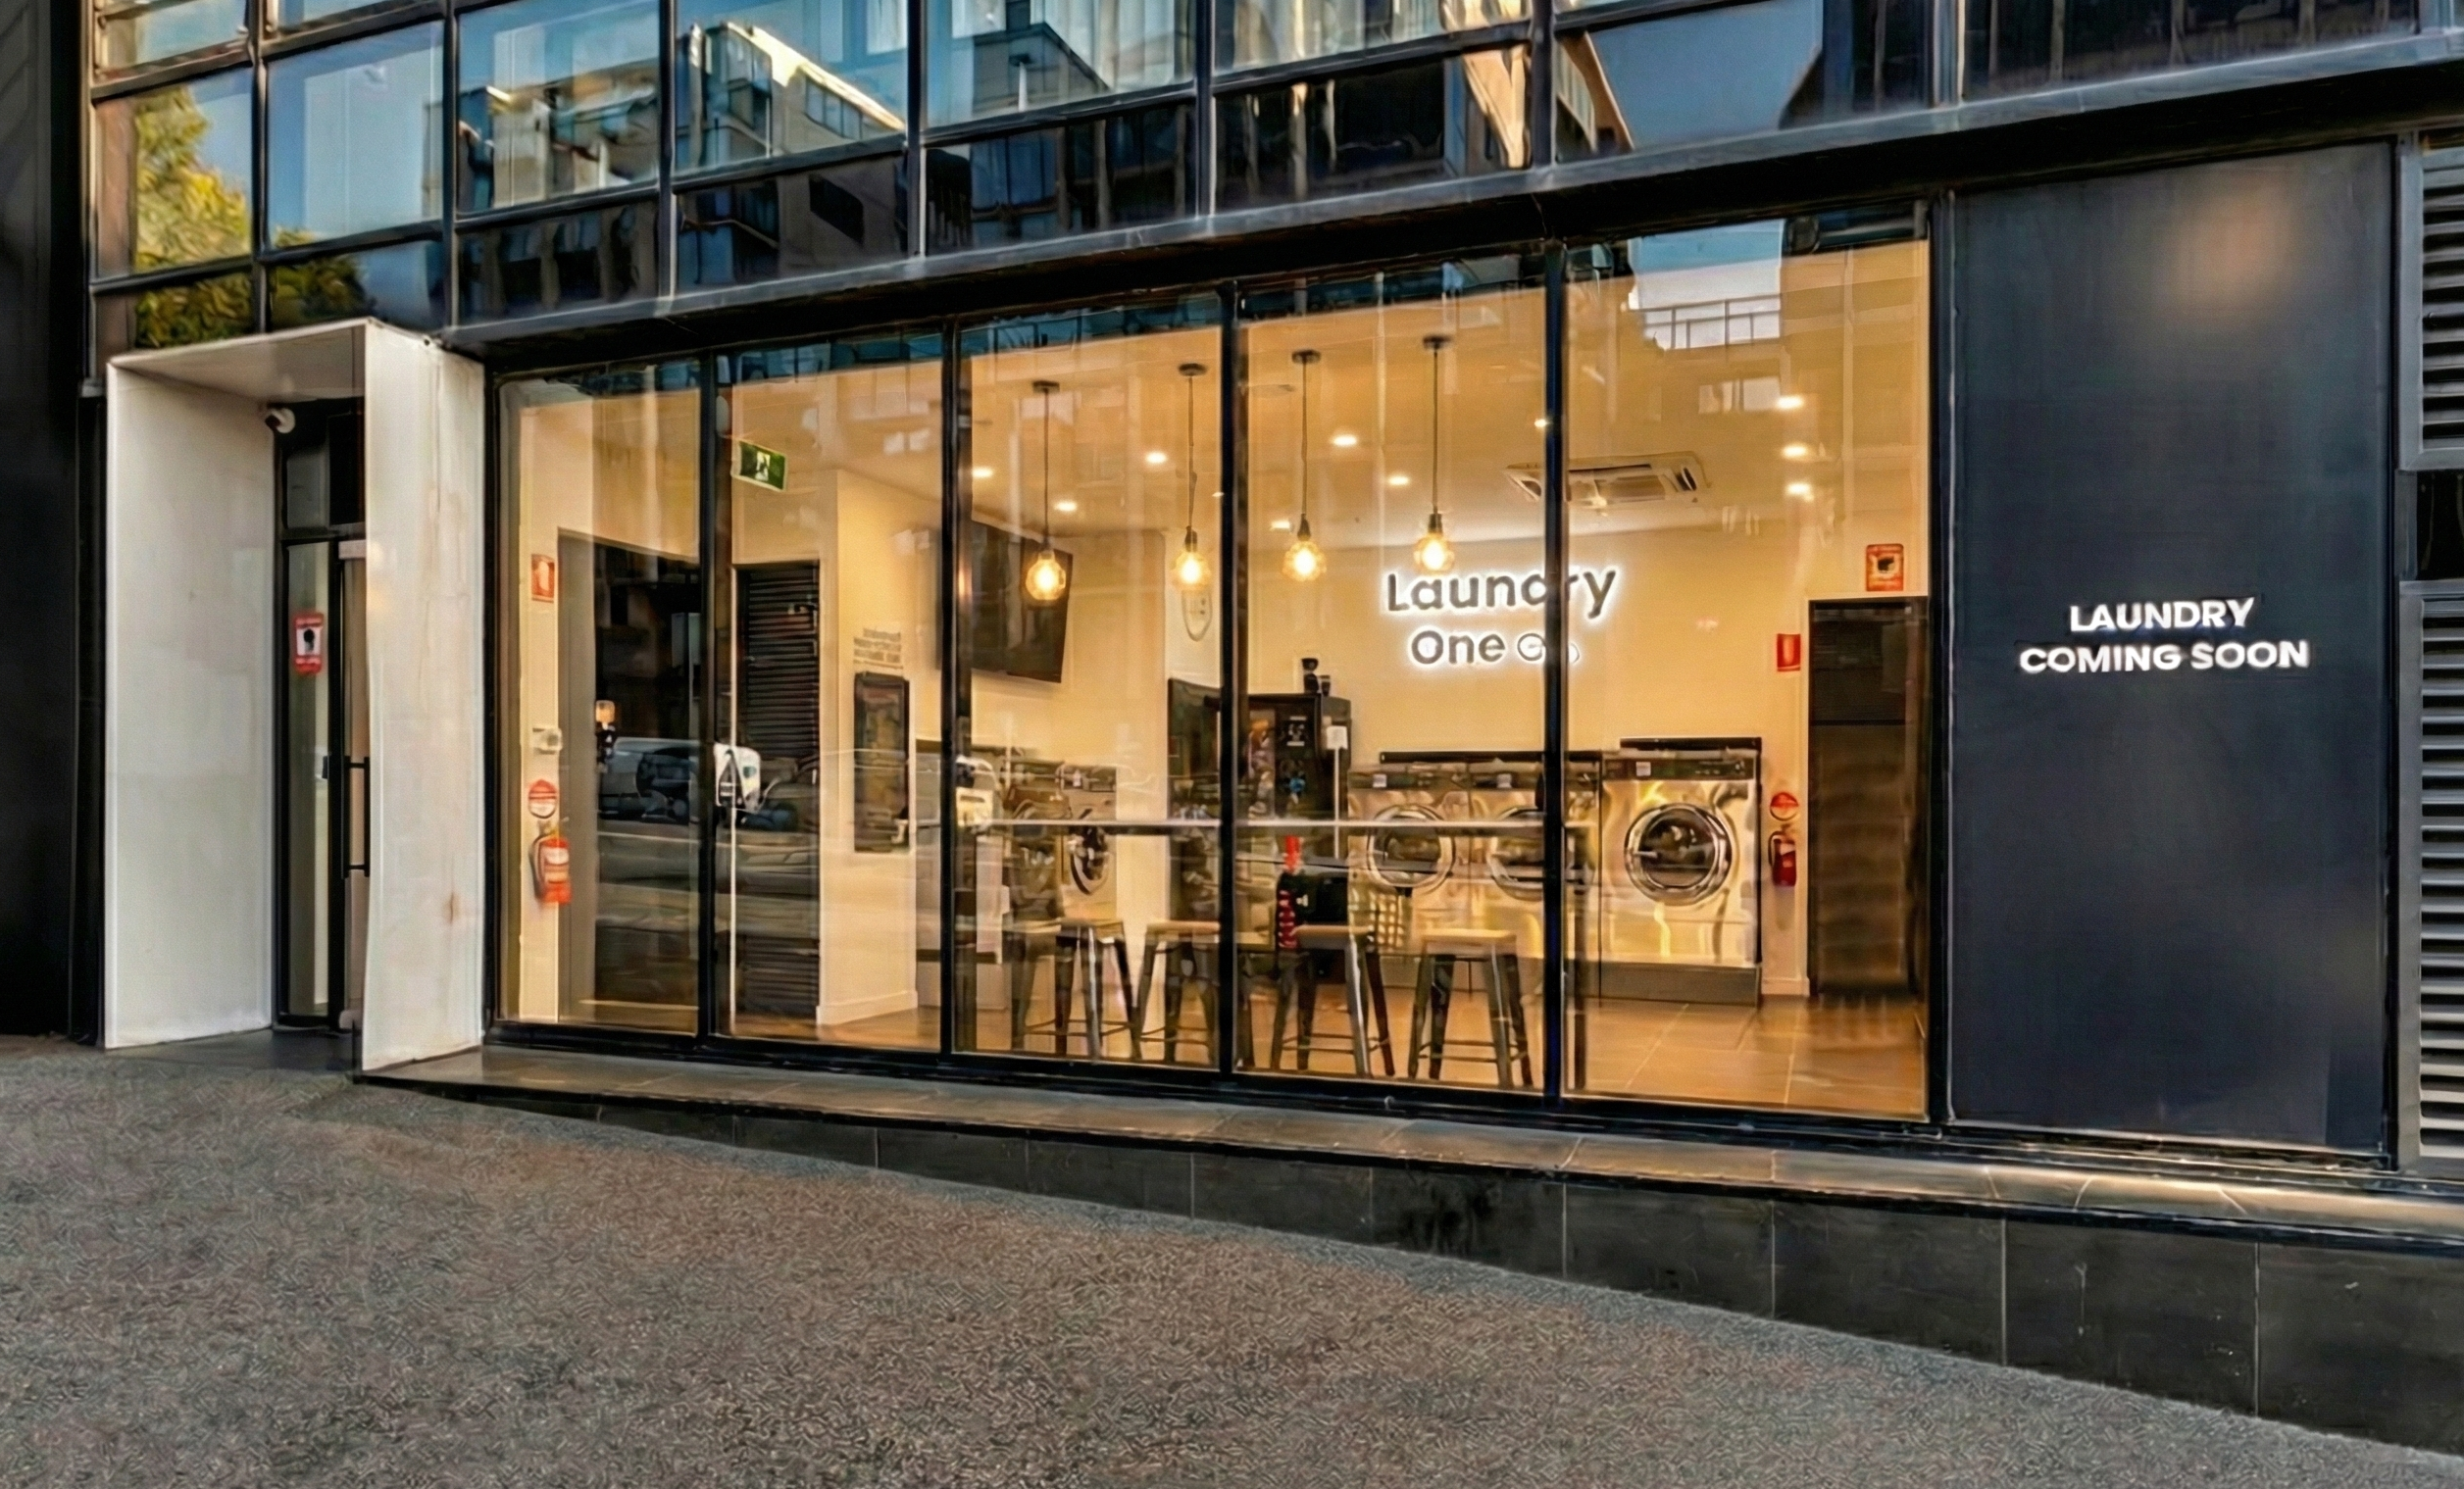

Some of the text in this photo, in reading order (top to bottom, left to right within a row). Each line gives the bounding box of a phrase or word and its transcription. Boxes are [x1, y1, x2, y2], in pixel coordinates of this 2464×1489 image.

[2069, 597, 2255, 632] LAUNDRY
[1411, 630, 1506, 665] One
[2019, 640, 2311, 673] COMING SOON
